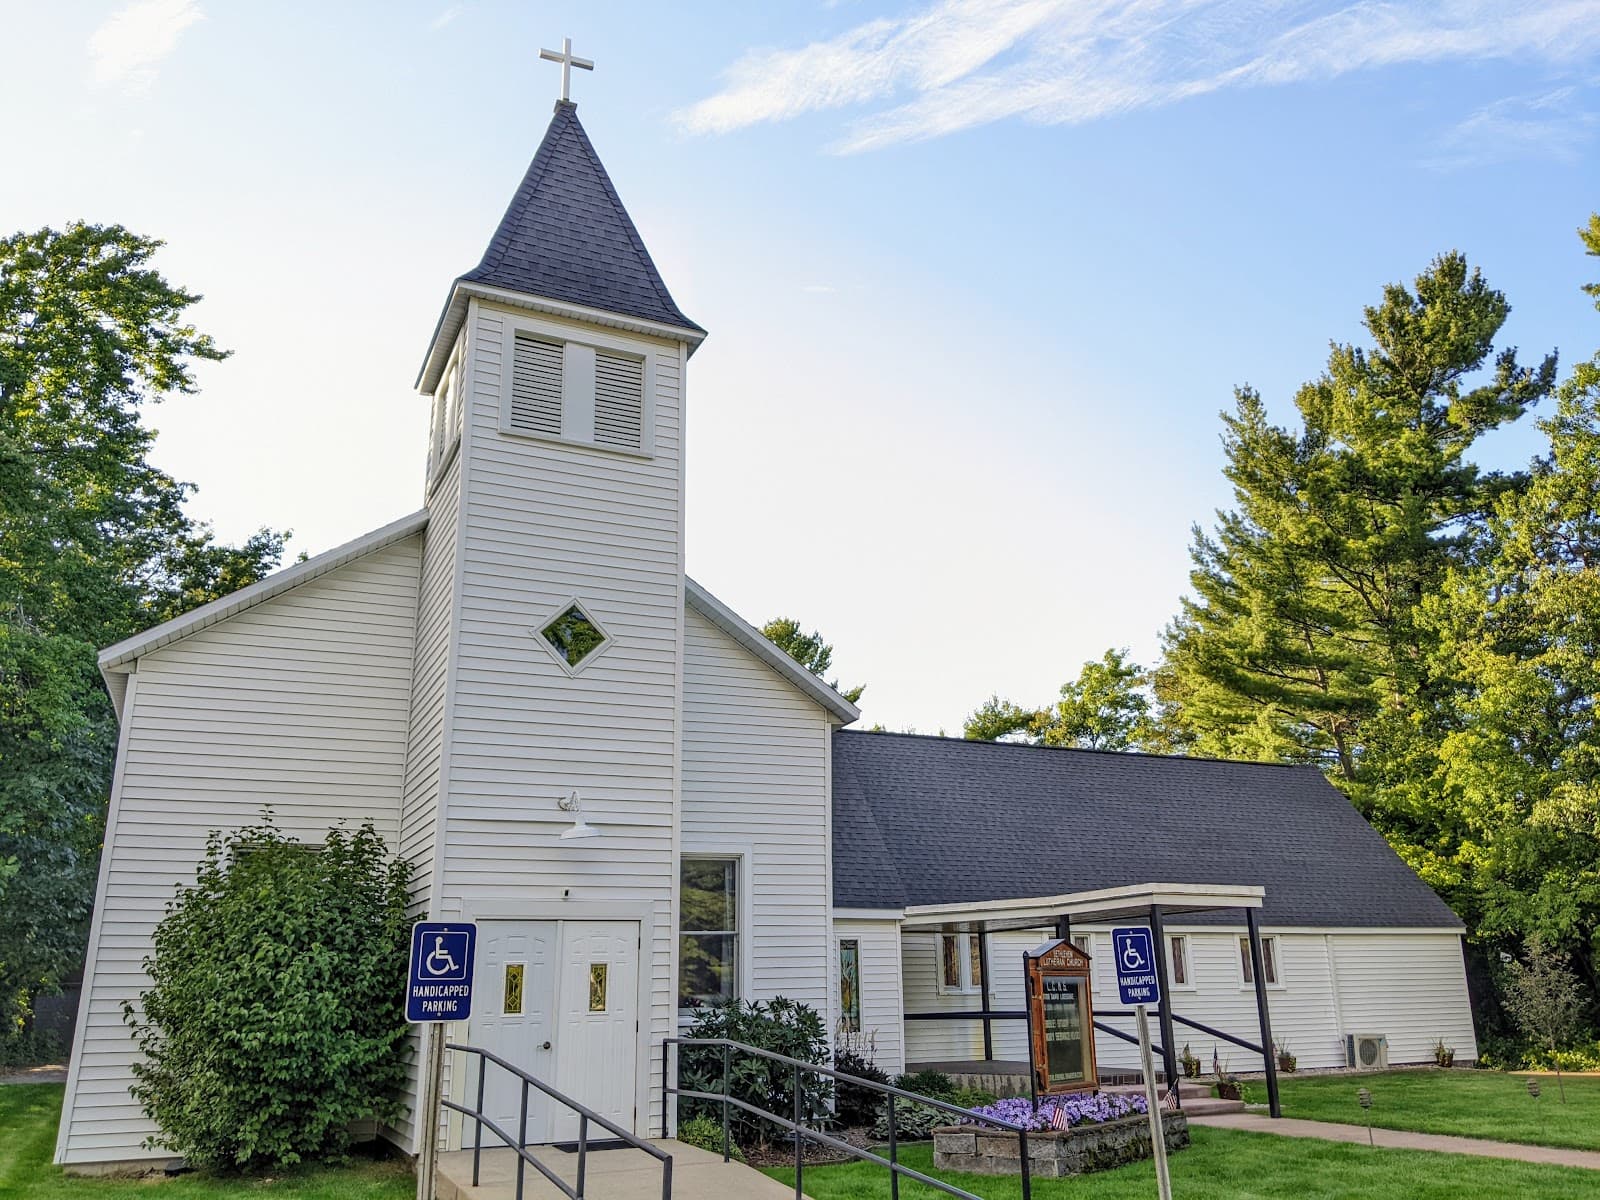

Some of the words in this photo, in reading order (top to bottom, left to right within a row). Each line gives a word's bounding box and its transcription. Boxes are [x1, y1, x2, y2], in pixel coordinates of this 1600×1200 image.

[1044, 957, 1066, 967] LUTHERAN
[1067, 958, 1084, 967] CHURCH
[1120, 976, 1155, 986] HANDICAPPED
[412, 985, 469, 997] HANDICAPPED
[1128, 987, 1151, 998] PARKING
[422, 1000, 458, 1012] PARKING
